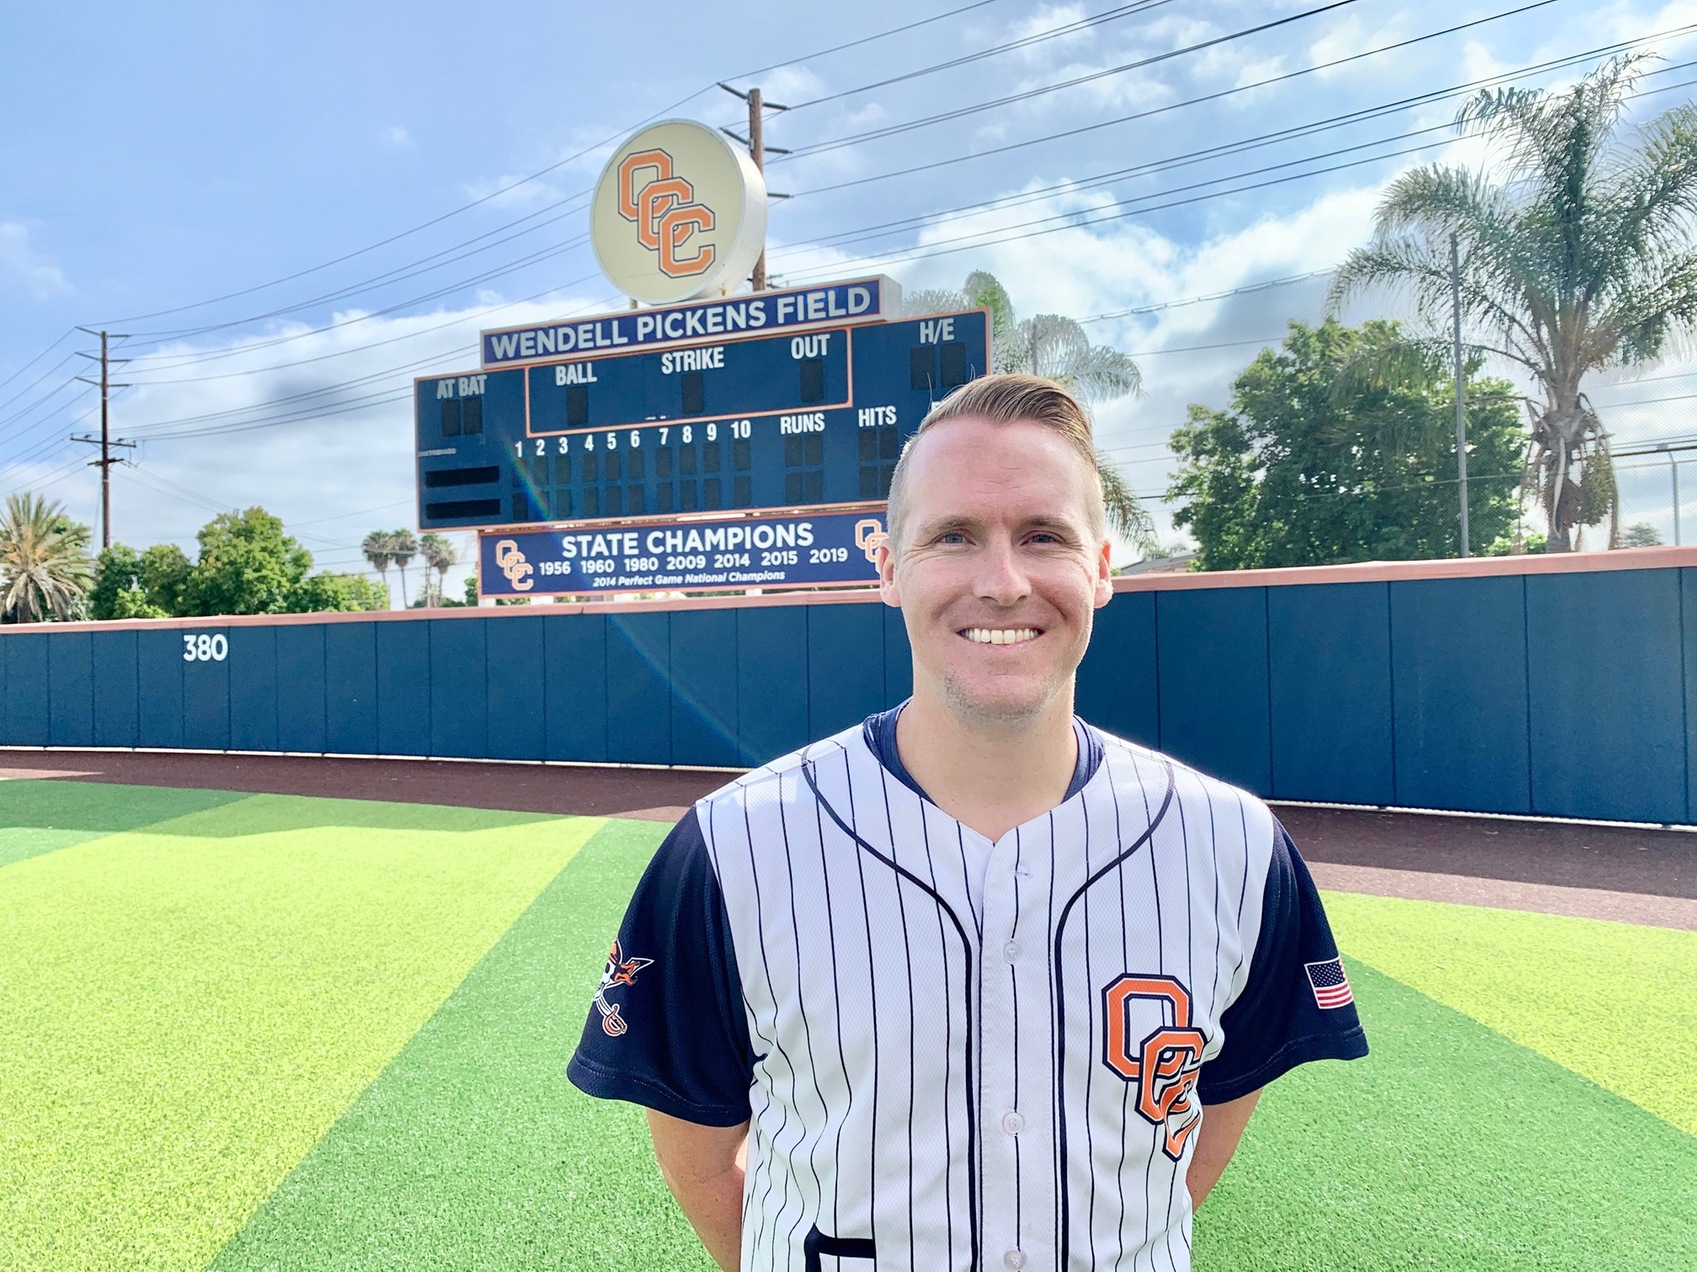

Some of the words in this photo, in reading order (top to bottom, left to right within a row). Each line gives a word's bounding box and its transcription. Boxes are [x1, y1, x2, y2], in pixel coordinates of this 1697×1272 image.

[618, 148, 716, 279] OCC
[490, 320, 629, 360] WENDELL
[637, 301, 766, 342] PICKENS
[777, 286, 871, 324] FIELD
[919, 318, 955, 345] H/E
[661, 346, 725, 375] STRIKE
[791, 333, 830, 360] OUT
[437, 378, 456, 400] AT
[458, 374, 487, 397] BAT
[555, 362, 598, 387] BALL
[780, 412, 825, 435] RUNS
[858, 405, 897, 427] HITS
[515, 440, 523, 458] 1
[535, 439, 546, 456] 2
[558, 437, 568, 454] 3
[584, 434, 594, 451] 4
[606, 432, 617, 450] 5
[630, 430, 640, 448] 6
[658, 427, 669, 445] 7
[682, 425, 693, 443] 8
[706, 423, 718, 441] 9
[731, 420, 751, 439] 10
[562, 532, 639, 559] STATE
[646, 522, 814, 554] CHAMPIONS
[496, 539, 534, 591] OCC
[539, 561, 571, 576] 1956
[581, 559, 615, 574] 1960
[624, 557, 659, 572] 1980
[666, 554, 706, 570] 2009
[714, 553, 751, 568] 2014
[761, 550, 798, 566] 2015
[809, 547, 848, 564] 2019
[593, 577, 616, 587] 2014
[618, 575, 653, 587] Perfect
[655, 573, 683, 585] Game
[685, 571, 727, 583] National
[729, 569, 786, 583] Champions
[183, 633, 228, 662] 380
